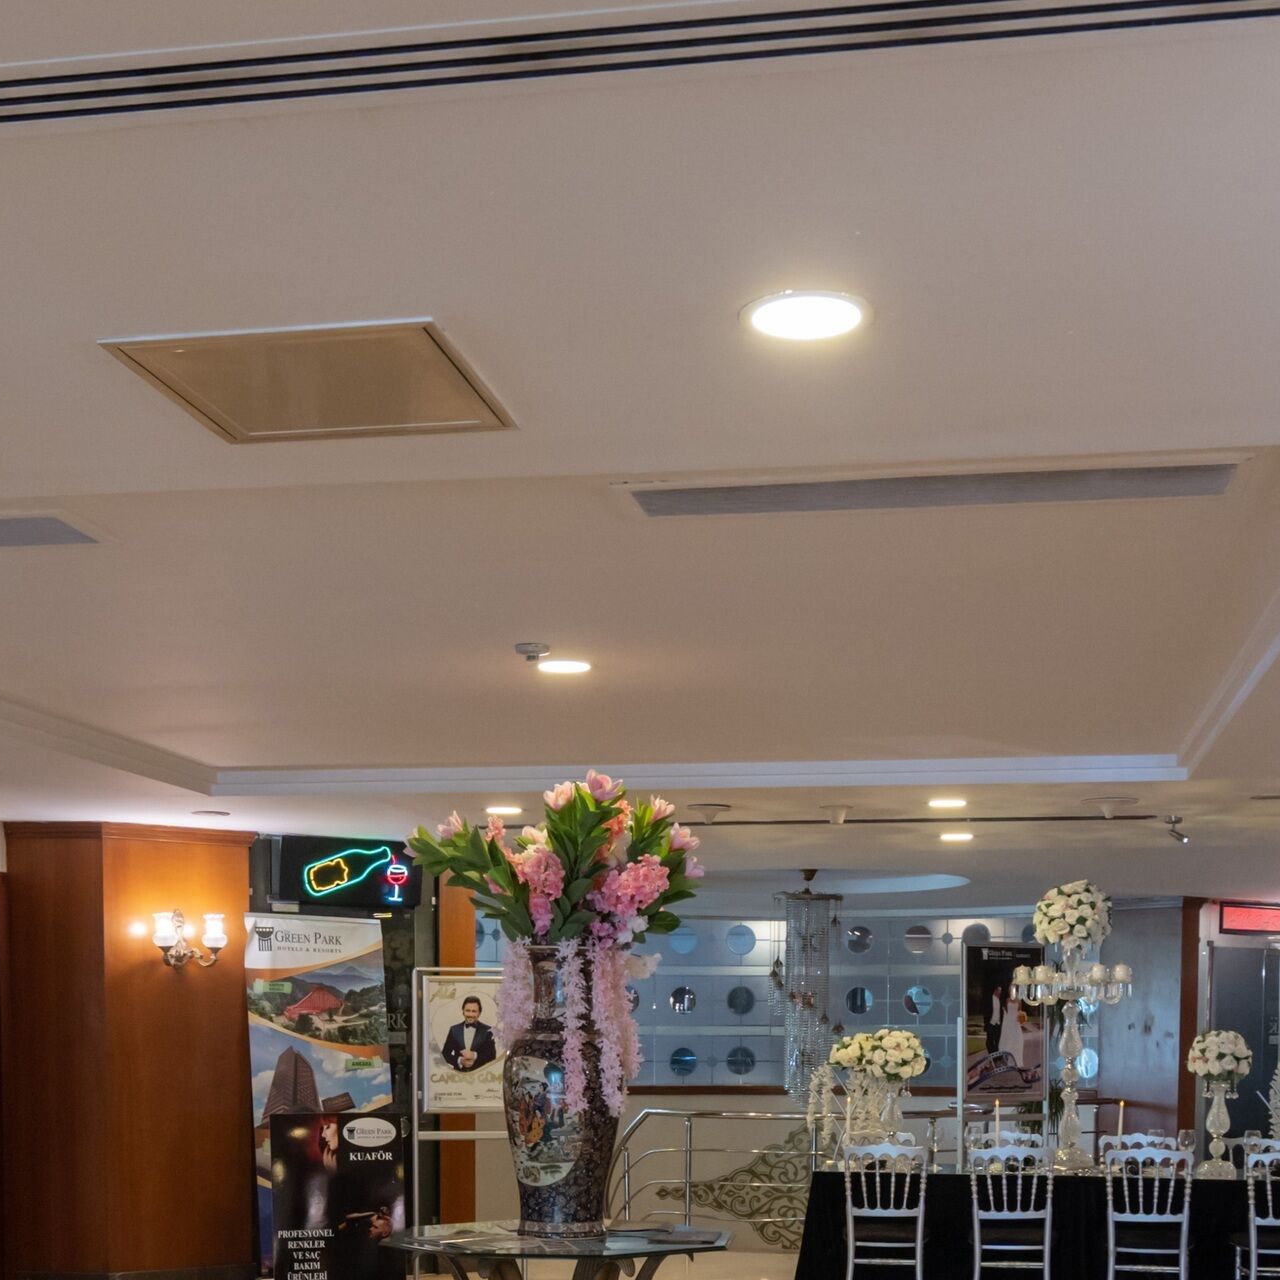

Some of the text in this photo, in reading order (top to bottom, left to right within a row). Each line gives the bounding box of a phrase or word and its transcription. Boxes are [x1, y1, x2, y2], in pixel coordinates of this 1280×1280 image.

[275, 930, 342, 945] GREEN PARK
[387, 1013, 408, 1029] RK
[349, 1150, 393, 1161] KUAFÖR
[277, 1229, 335, 1239] PROFESYONEL
[287, 1240, 326, 1249] RENKLER
[292, 1251, 321, 1260] VE SAÇ
[293, 1262, 321, 1271] BAKIM
